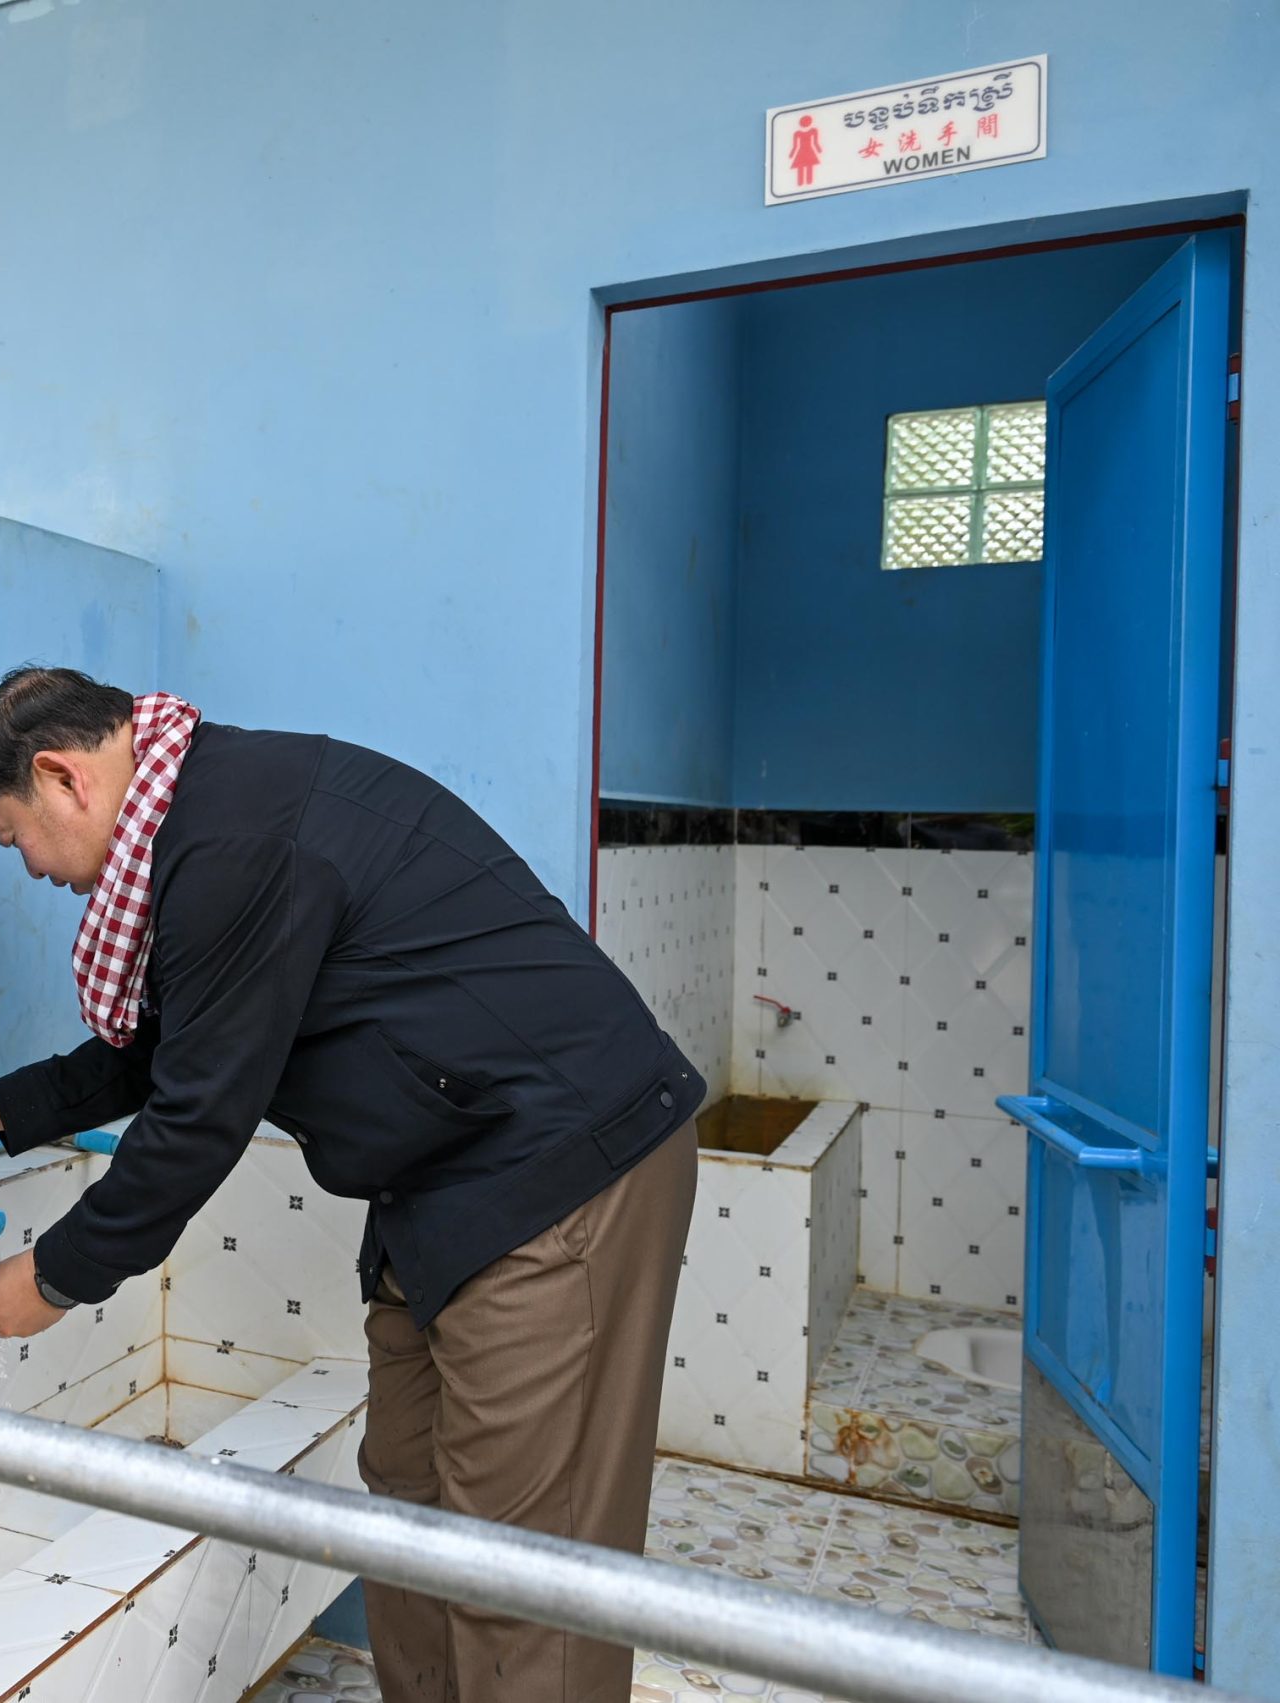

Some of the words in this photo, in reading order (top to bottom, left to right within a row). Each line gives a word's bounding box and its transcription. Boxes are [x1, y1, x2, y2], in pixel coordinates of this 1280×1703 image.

[843, 71, 1014, 131] បន្ទប់ទឹកស្រី
[857, 114, 999, 159] 女洗手間
[883, 145, 971, 175] WOMEN
